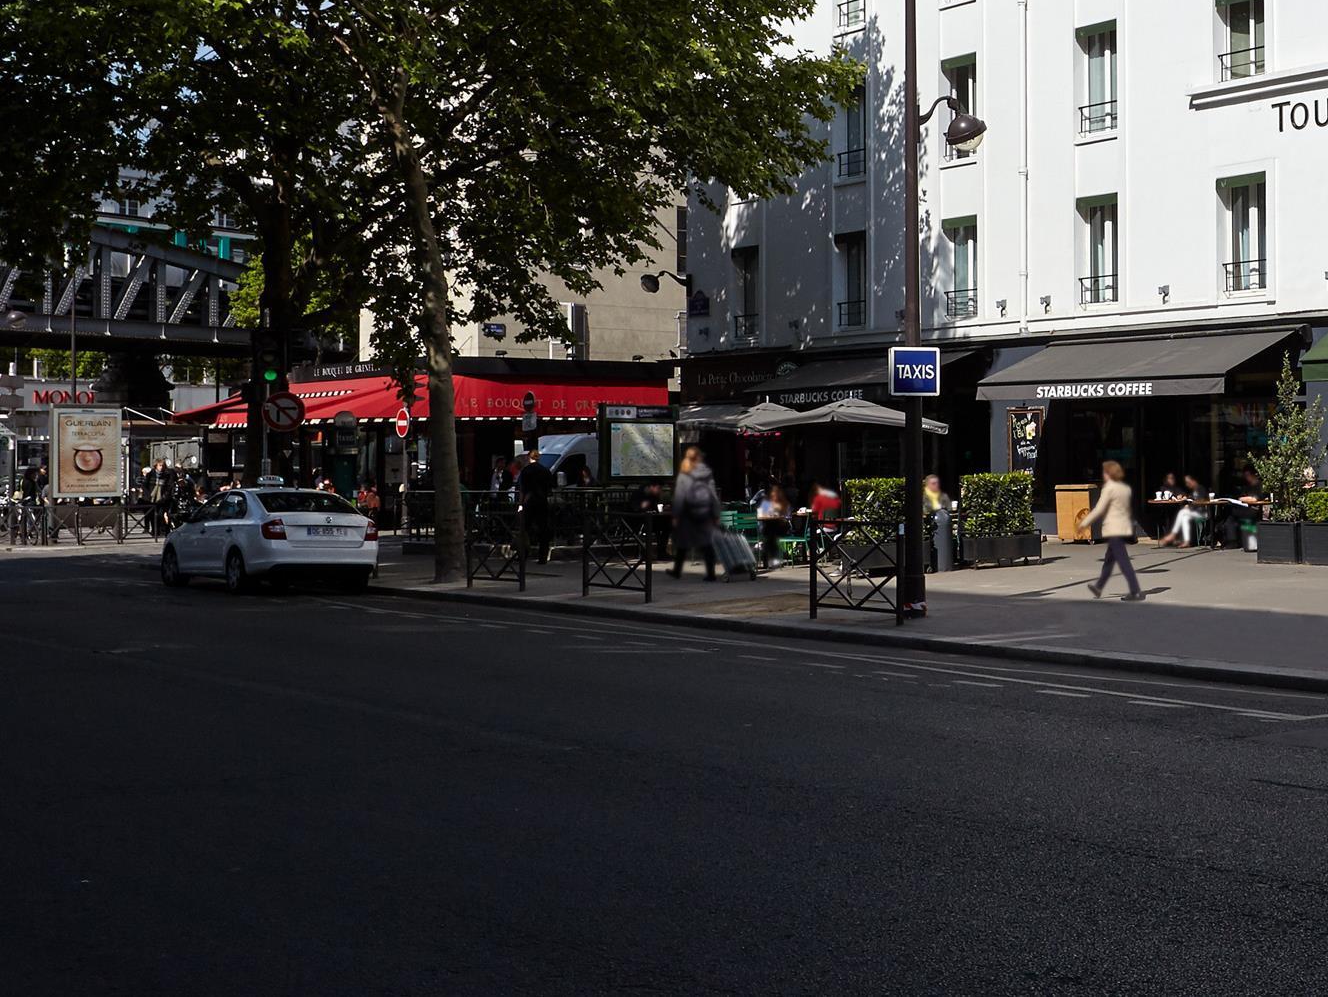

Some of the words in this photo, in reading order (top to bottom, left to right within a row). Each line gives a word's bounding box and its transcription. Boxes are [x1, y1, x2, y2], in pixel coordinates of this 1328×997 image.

[896, 364, 935, 380] TAXIS
[779, 390, 829, 404] STARBUCKS
[1036, 384, 1104, 399] STARBUCKS
[1107, 383, 1153, 396] COFFEE
[65, 419, 111, 427] GUERLAIN
